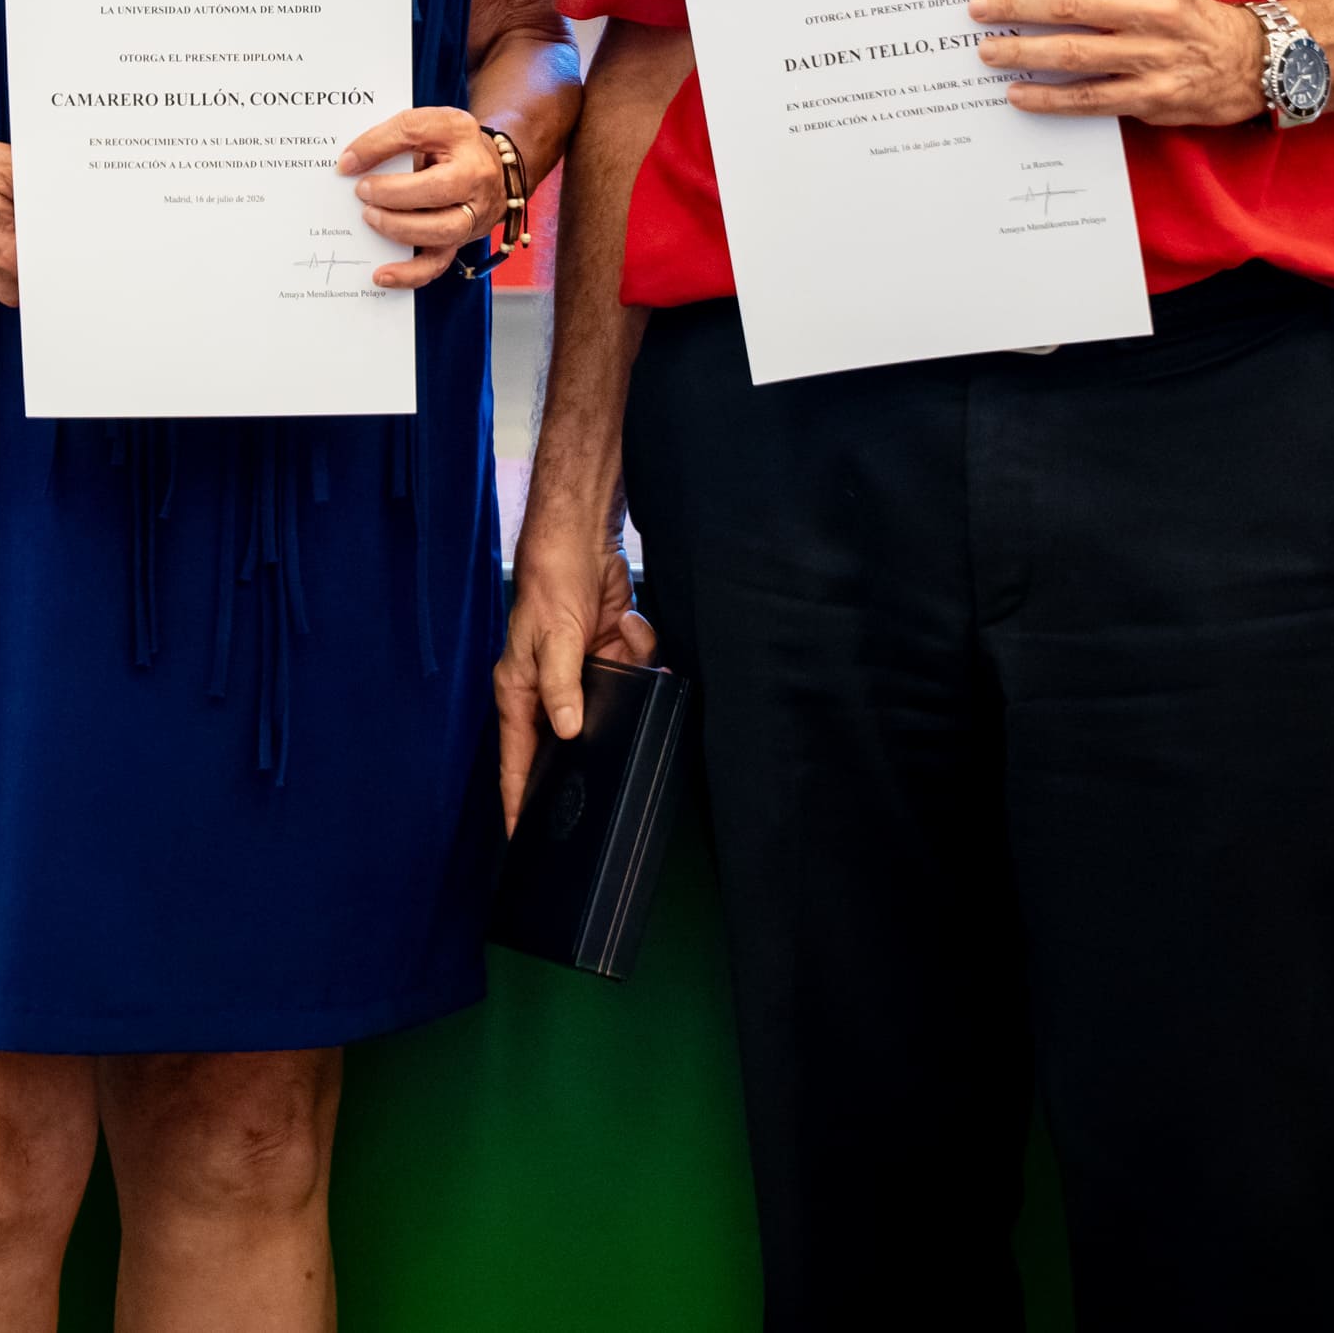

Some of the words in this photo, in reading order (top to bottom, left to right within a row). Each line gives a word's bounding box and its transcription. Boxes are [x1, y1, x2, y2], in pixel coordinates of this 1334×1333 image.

[100, 5, 114, 15] LA
[117, 5, 191, 15] UNIVERSIDAD
[193, 3, 257, 15] AUTÓNOMA
[259, 5, 274, 15] DE
[276, 4, 322, 14] MADRID
[804, 11, 851, 26] OTORGA
[854, 9, 868, 19] EL
[870, 0, 925, 17] PRESENTE
[119, 53, 165, 63] OTORGA
[168, 53, 182, 63] EL
[184, 53, 240, 63] PRESENTE
[242, 52, 293, 62] DIPLOMA
[295, 53, 303, 62] A
[785, 48, 861, 73] DAUDEN
[866, 39, 934, 60] TELLO,
[51, 92, 158, 107] CAMARERO
[164, 88, 245, 107] BULLÓN,
[249, 86, 374, 106] CONCEPCIÓN
[786, 102, 799, 112] EN
[802, 88, 897, 110] RECONOCIMIENTO
[899, 87, 906, 96] A
[908, 85, 918, 94] SU
[923, 80, 960, 93] LABOR,
[962, 78, 973, 88] SU
[977, 73, 1025, 85] ENTREGA
[788, 125, 801, 134] SU
[804, 113, 868, 132] DEDICACIÓN
[870, 114, 877, 122] A
[880, 111, 894, 121] LA
[895, 102, 959, 119] COMUNIDAD
[960, 97, 1007, 109] UNIVERSI
[89, 137, 102, 147] EN
[104, 137, 198, 147] RECONOCIMIENTO
[200, 138, 208, 146] A
[209, 137, 222, 146] SU
[225, 137, 262, 146] LABOR,
[264, 137, 277, 146] SU
[279, 136, 327, 146] ENTREGA
[330, 136, 337, 145] Y
[911, 142, 922, 151] de
[922, 139, 941, 152] julio
[941, 138, 952, 147] de
[89, 161, 101, 170] SU
[104, 159, 167, 170] DEDICACIÓN
[169, 161, 176, 170] A
[179, 160, 192, 170] LA
[194, 160, 257, 169] COMUNIDAD
[1020, 161, 1032, 171] La
[163, 194, 193, 204] Madrid,
[205, 194, 215, 203] de
[216, 194, 234, 205] julio
[235, 194, 245, 203] de
[309, 227, 320, 237] La
[278, 290, 304, 301] Amaya
[360, 289, 386, 300] Pelayo
